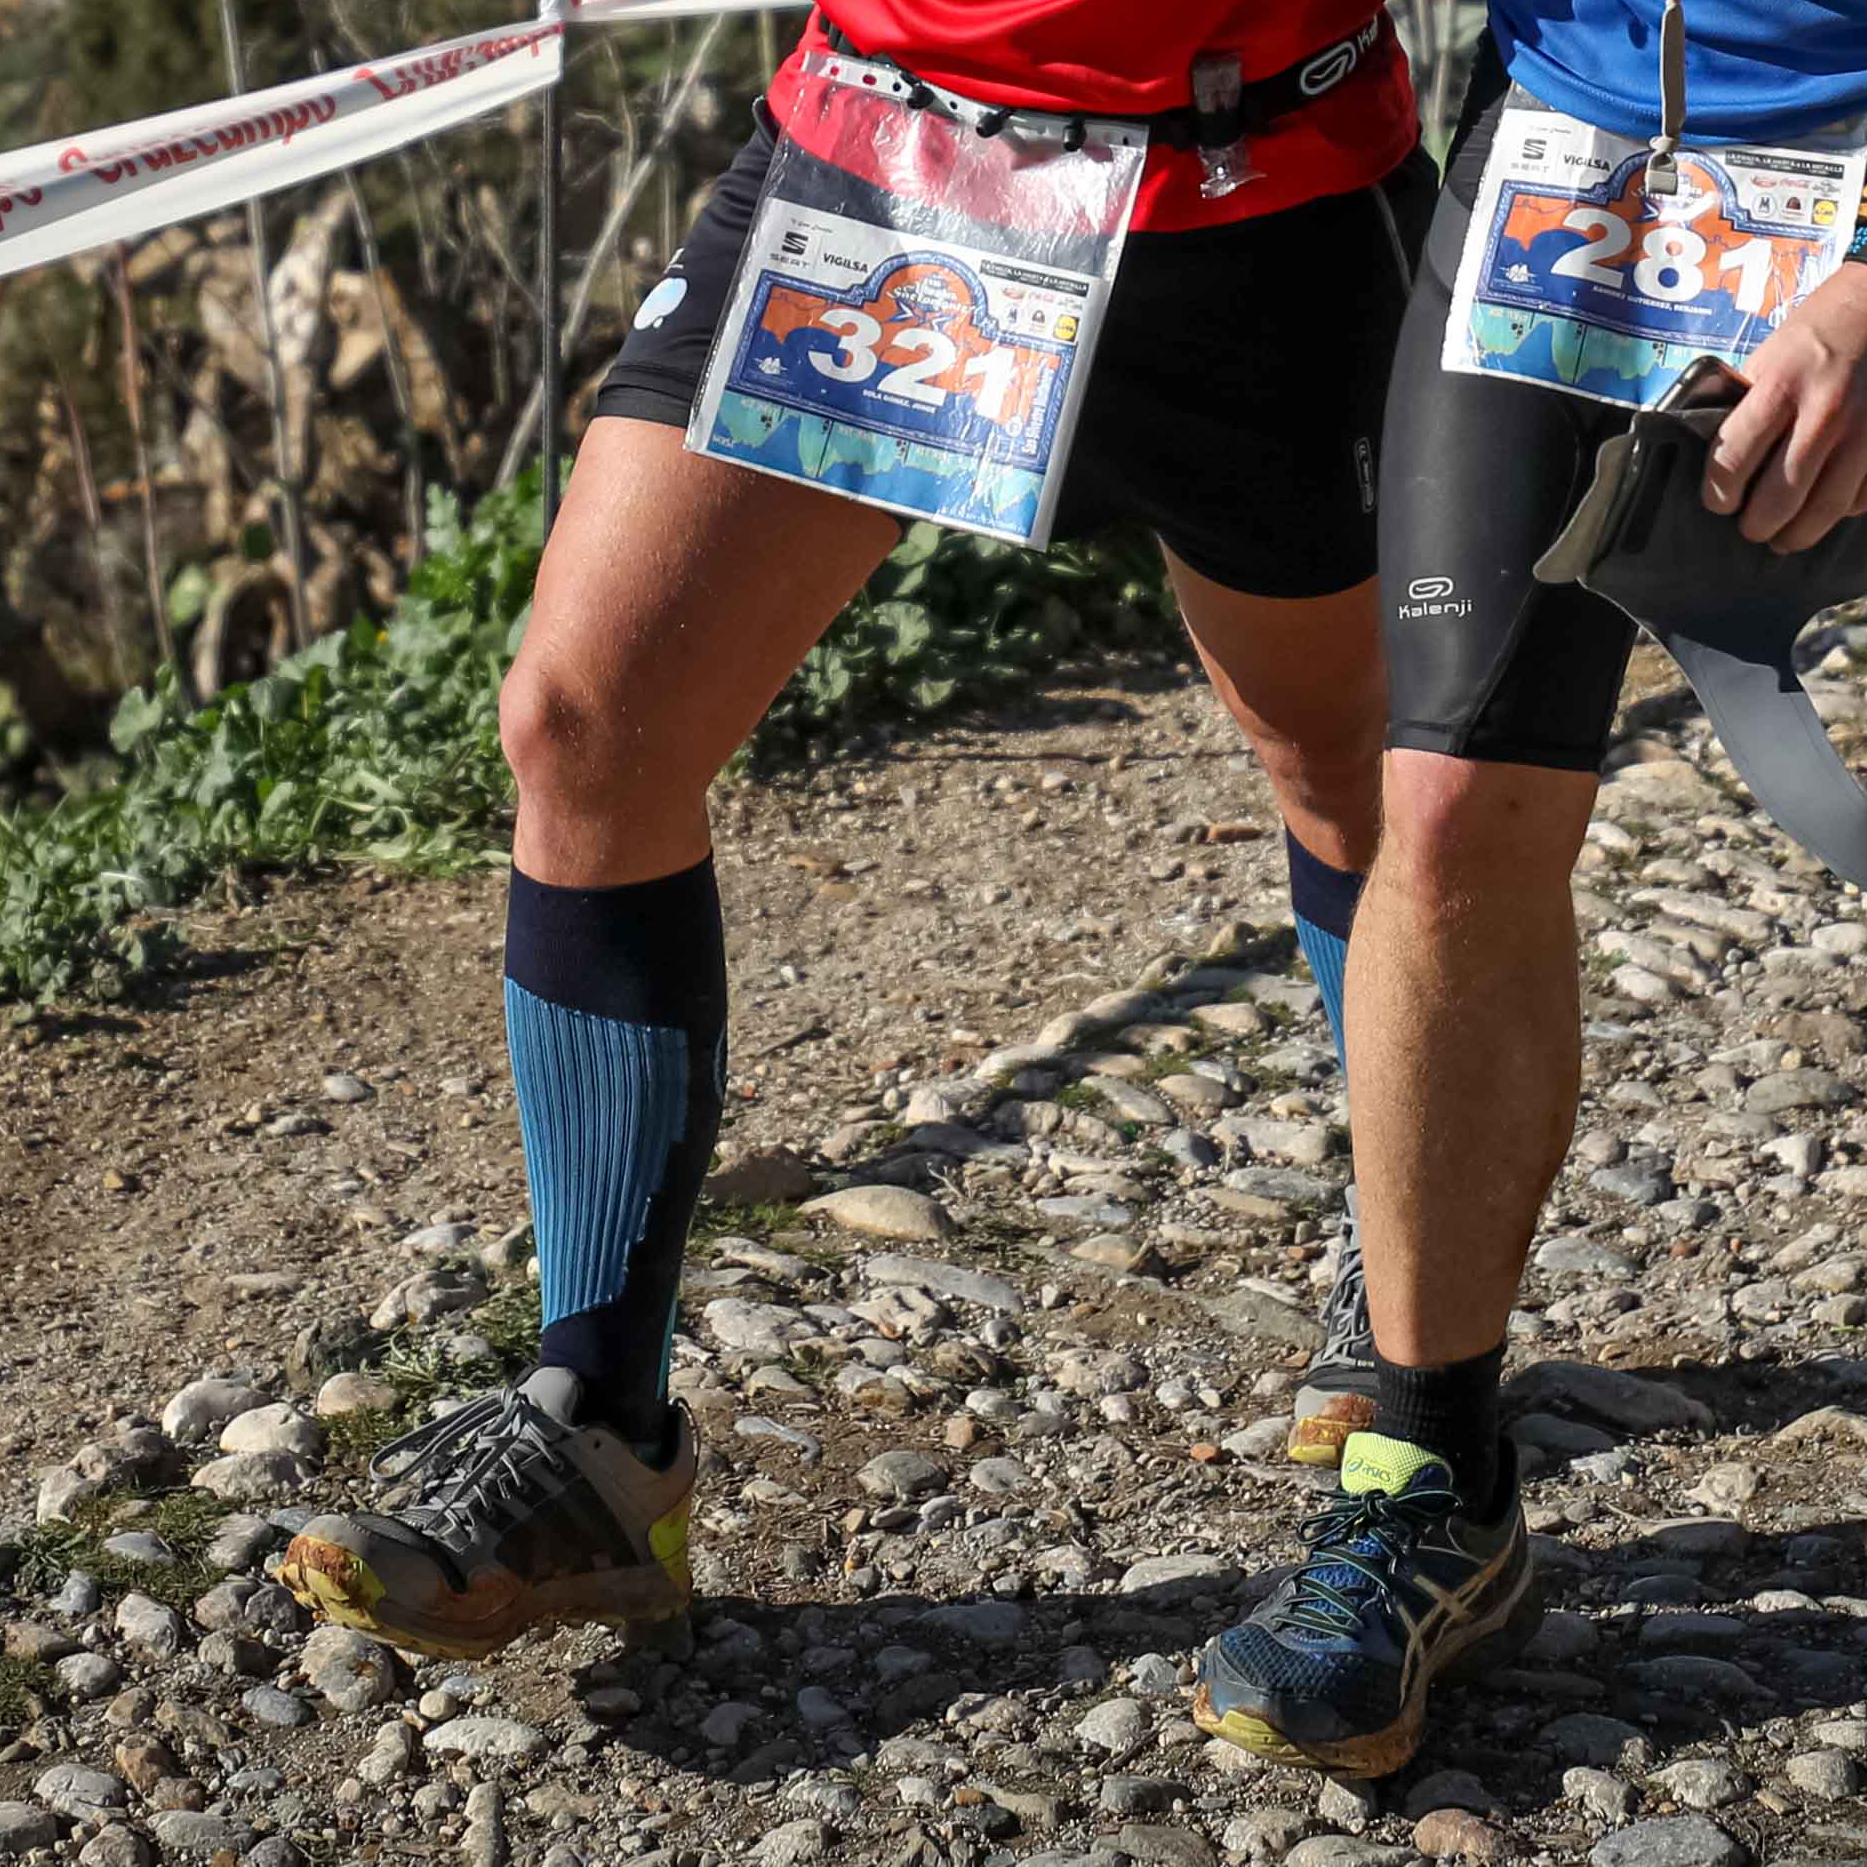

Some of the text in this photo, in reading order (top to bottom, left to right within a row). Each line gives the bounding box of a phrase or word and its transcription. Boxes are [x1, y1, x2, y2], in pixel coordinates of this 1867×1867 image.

[1563, 153, 1611, 173] VIGILSA
[823, 252, 868, 273] VIGILSA
[1549, 207, 1773, 312] 281
[807, 307, 1015, 422] 321
[1398, 599, 1473, 620] Kalenji
